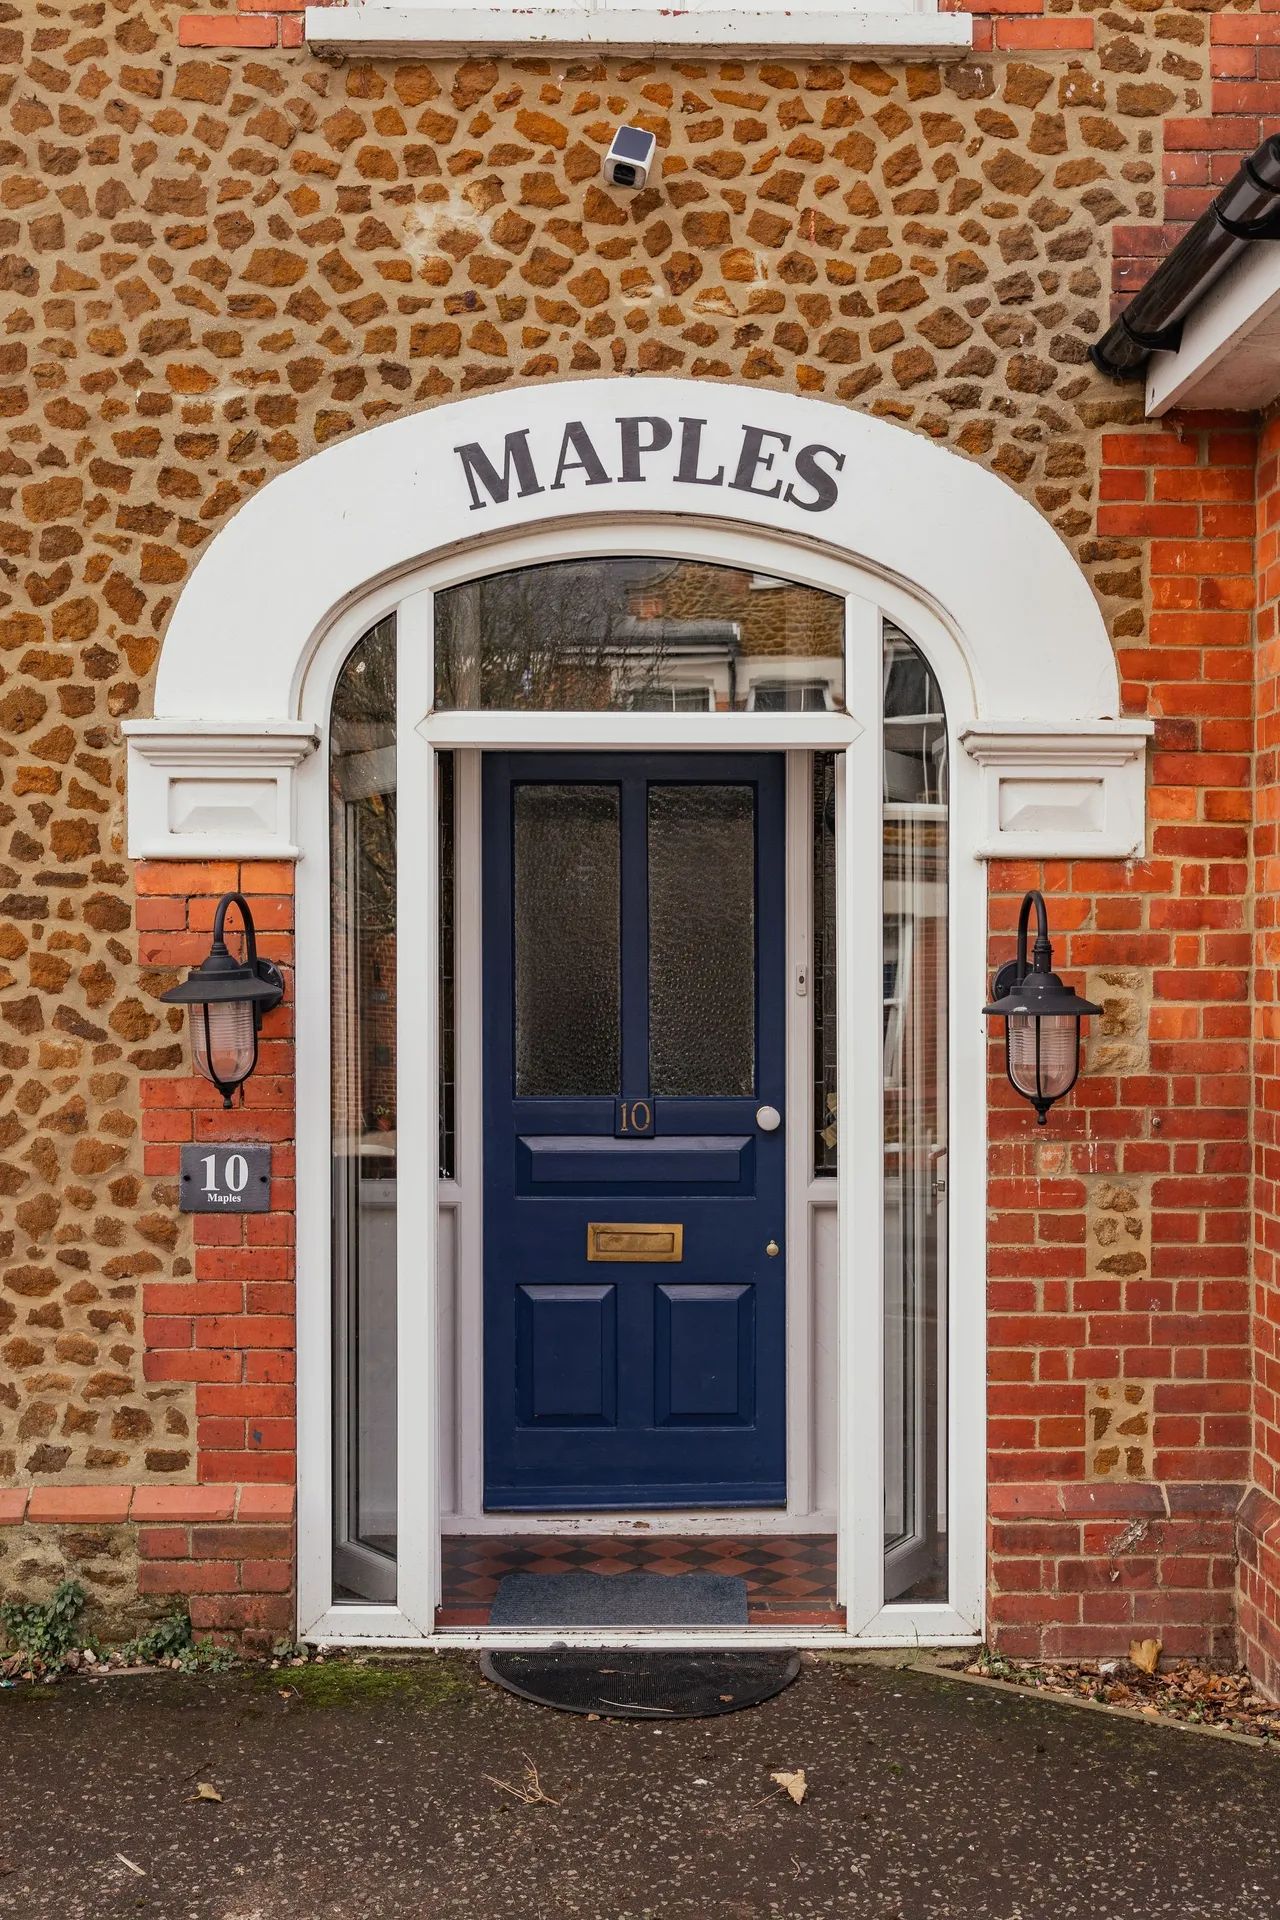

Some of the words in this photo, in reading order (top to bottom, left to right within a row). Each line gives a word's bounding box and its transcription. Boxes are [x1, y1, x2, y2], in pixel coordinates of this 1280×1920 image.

[453, 416, 846, 512] MAPLES
[620, 1102, 650, 1132] 10
[200, 1154, 249, 1192] 10
[207, 1193, 242, 1204] Maples
